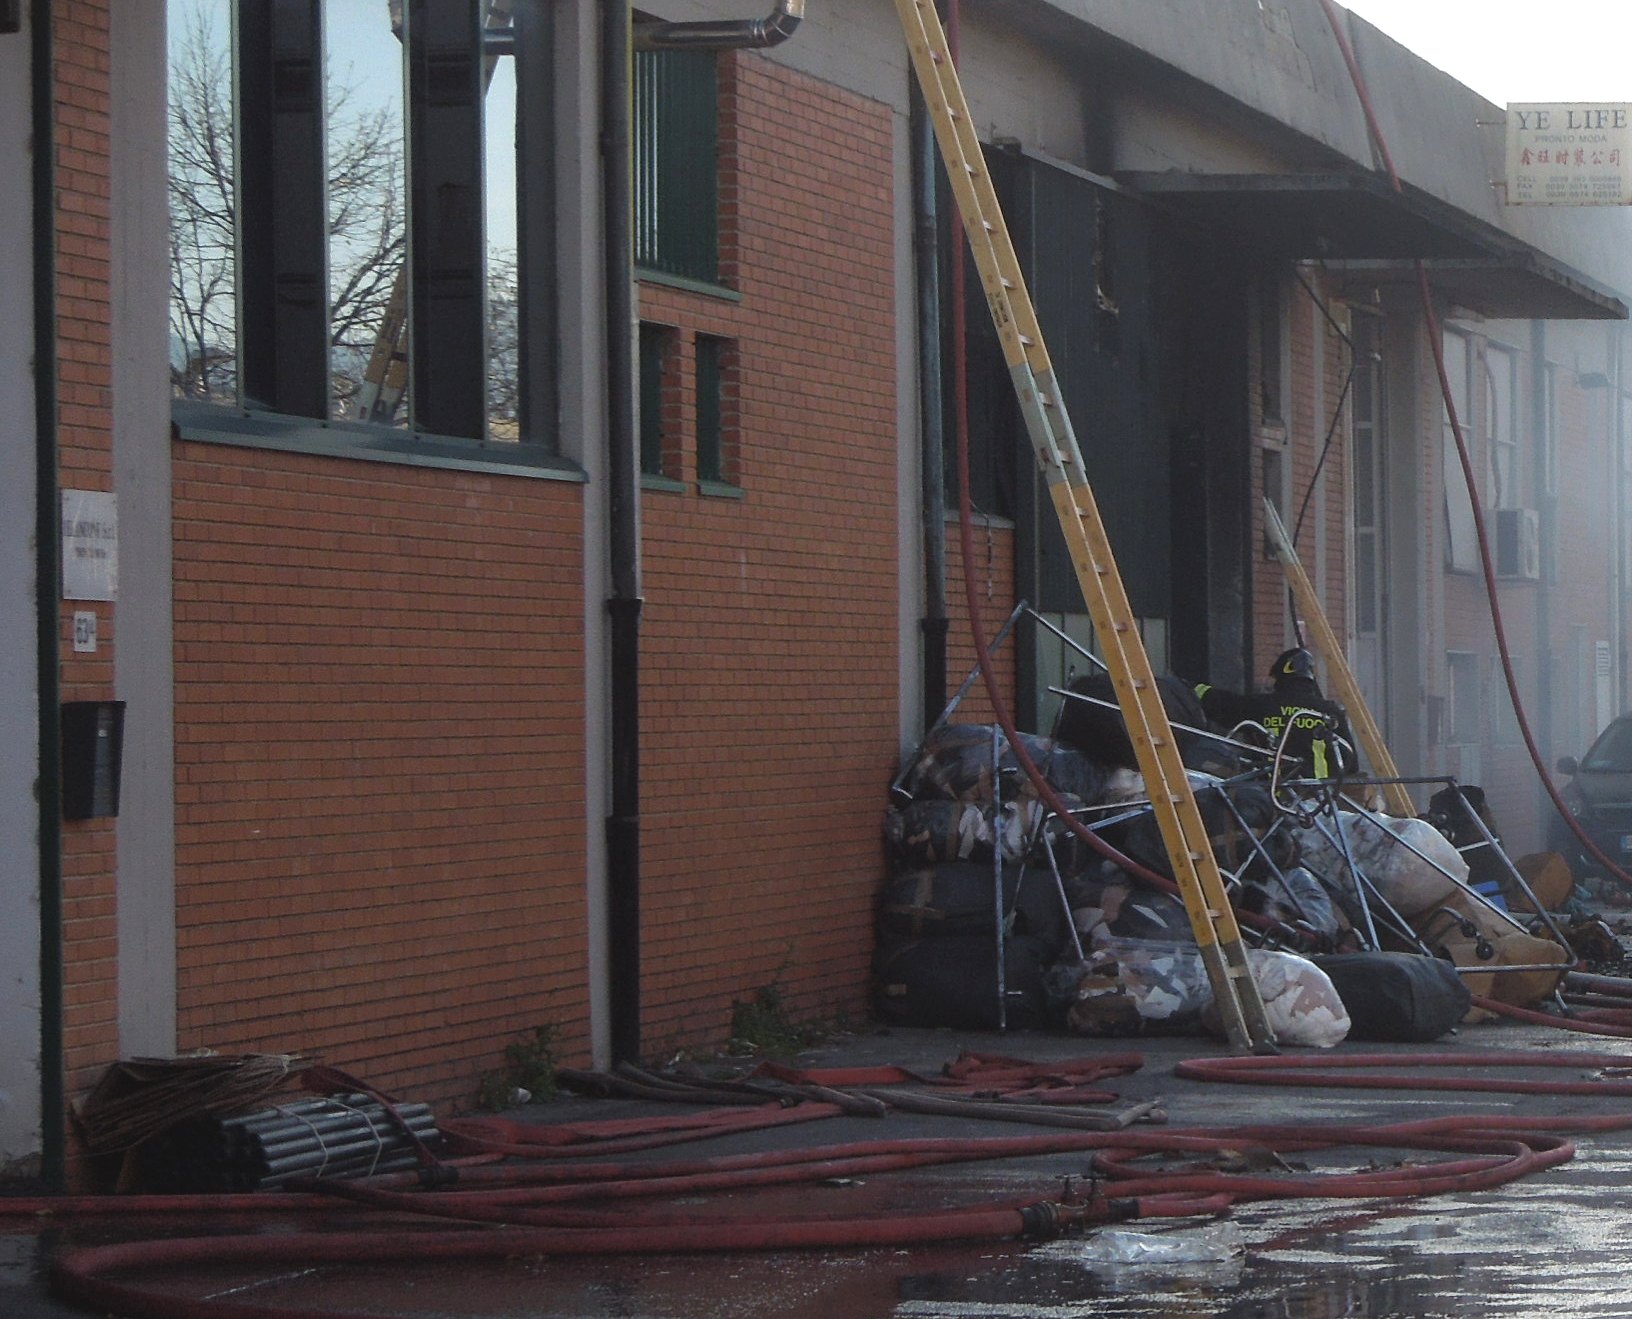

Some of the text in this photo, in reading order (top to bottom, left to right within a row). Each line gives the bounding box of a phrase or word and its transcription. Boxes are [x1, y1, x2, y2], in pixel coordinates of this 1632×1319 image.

[1516, 109, 1628, 129] YE LIFE
[1535, 134, 1608, 143] PRONTO MODA
[1263, 716, 1285, 728] DEL
